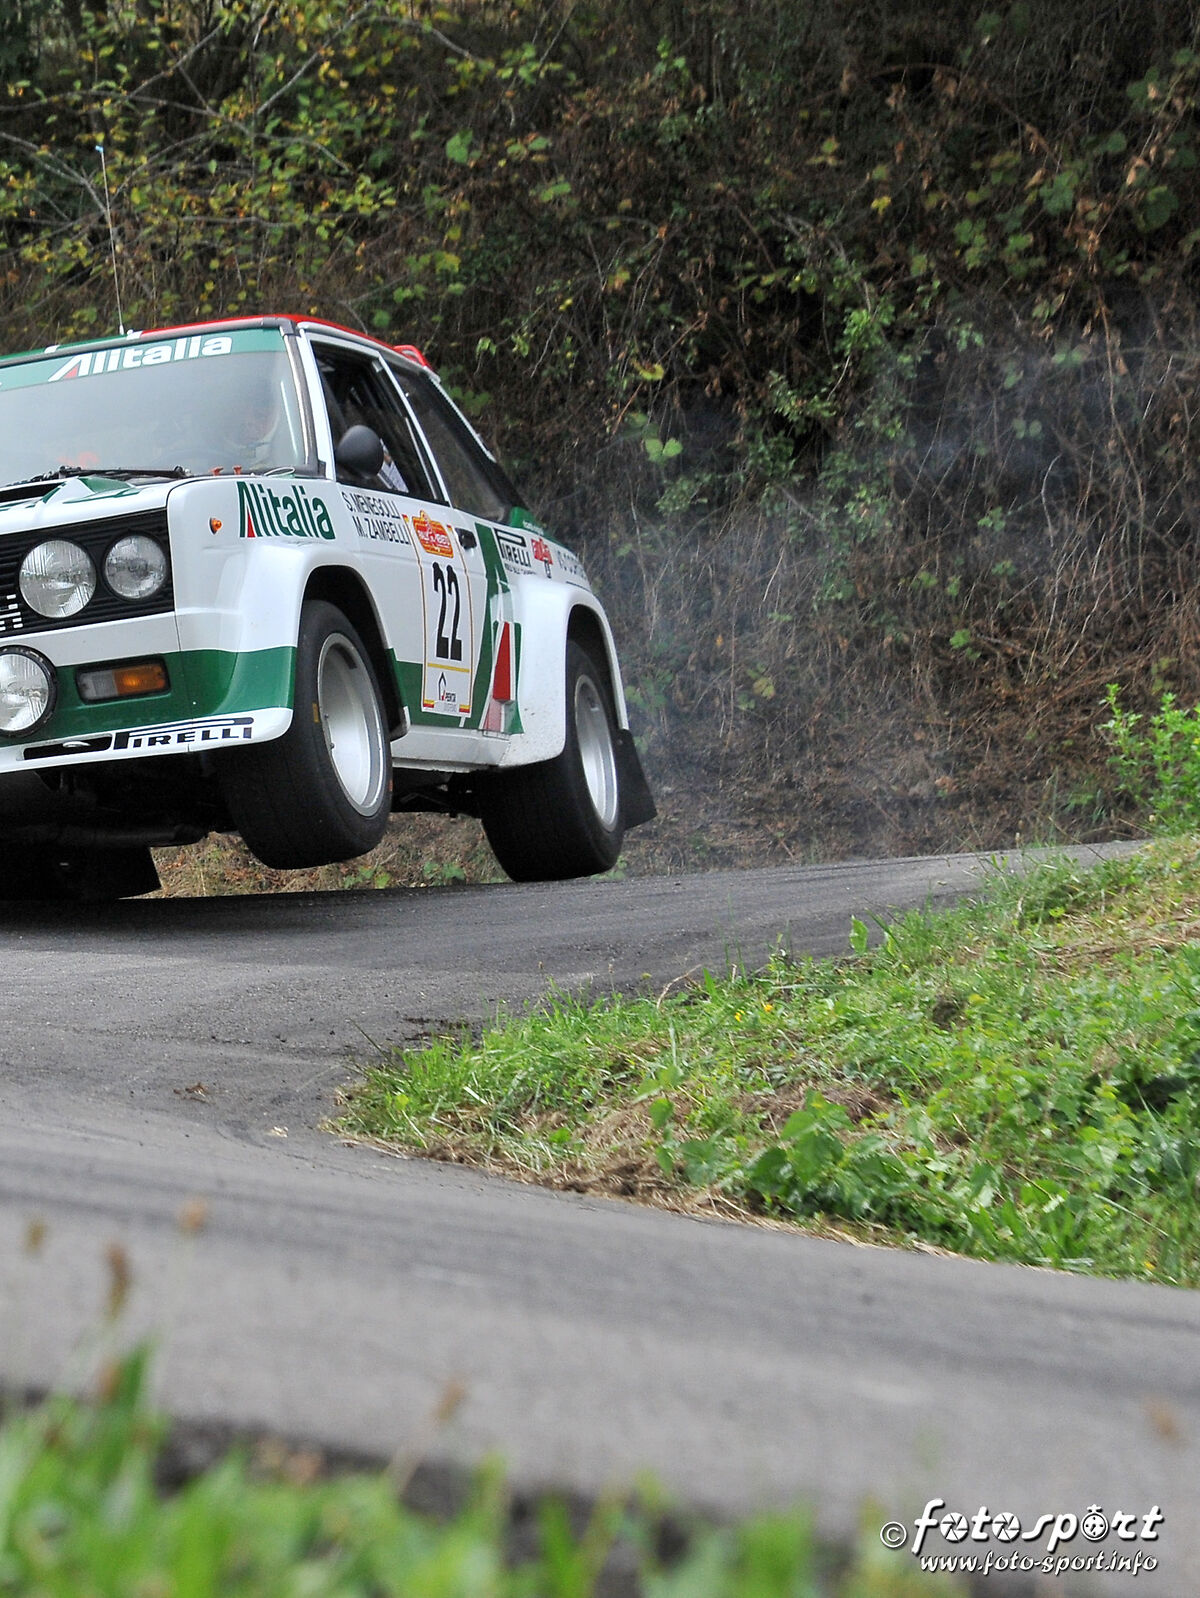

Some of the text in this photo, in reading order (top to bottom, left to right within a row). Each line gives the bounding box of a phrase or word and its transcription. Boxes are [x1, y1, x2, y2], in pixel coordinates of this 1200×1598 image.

[48, 335, 232, 382] Alitalia
[236, 481, 336, 540] Alitalia
[341, 491, 356, 512] S.
[352, 515, 411, 545] M. ZAMBELLI
[493, 527, 532, 568] PIRELLI
[432, 561, 462, 661] 22
[113, 717, 255, 750] PIRELLI
